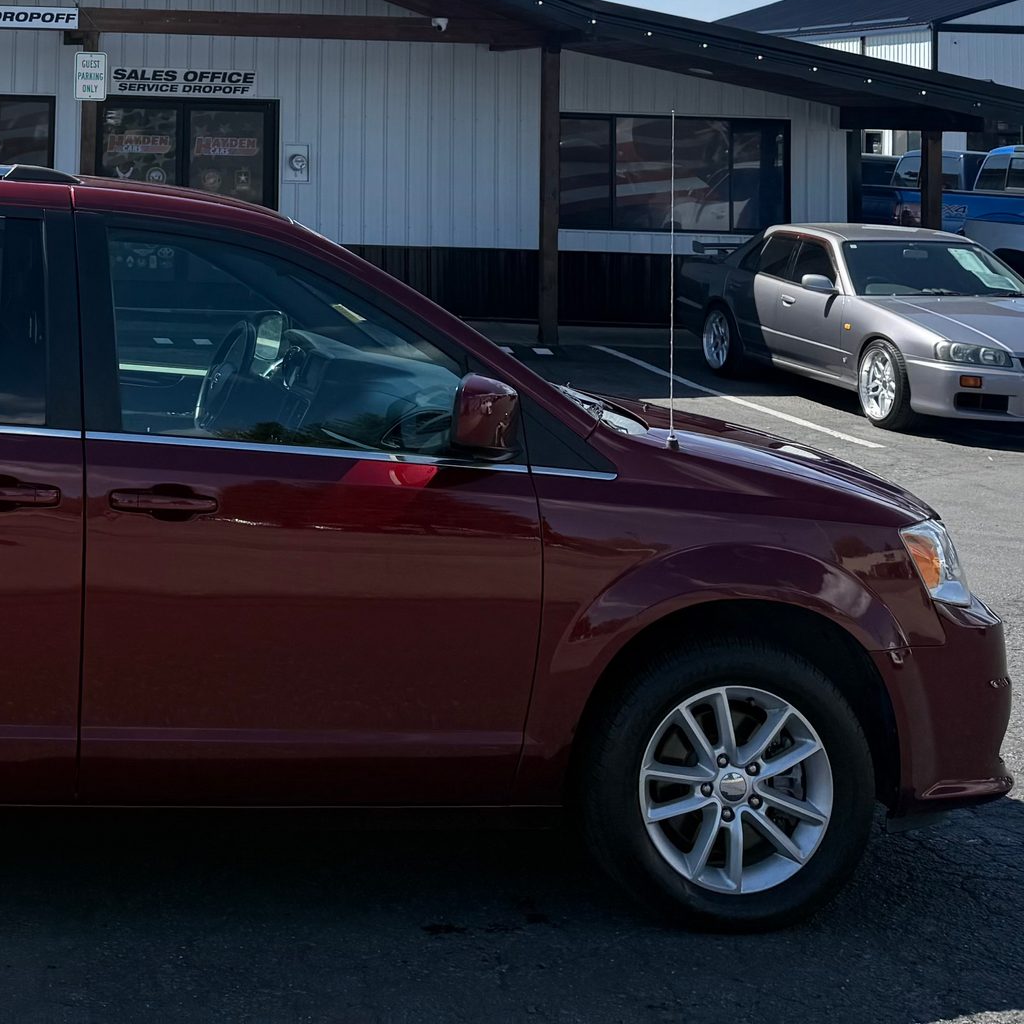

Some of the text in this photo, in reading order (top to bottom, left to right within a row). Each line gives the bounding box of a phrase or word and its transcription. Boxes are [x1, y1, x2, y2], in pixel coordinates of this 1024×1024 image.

[81, 60, 100, 68] GUEST
[77, 71, 104, 81] PARKING
[112, 68, 256, 84] SALES OFFICE
[82, 84, 98, 93] ONLY
[118, 82, 250, 94] SERVICE DROPOFF
[107, 134, 170, 152] HAYDEN
[194, 136, 257, 155] HAYDEN
[942, 204, 968, 215] X4
